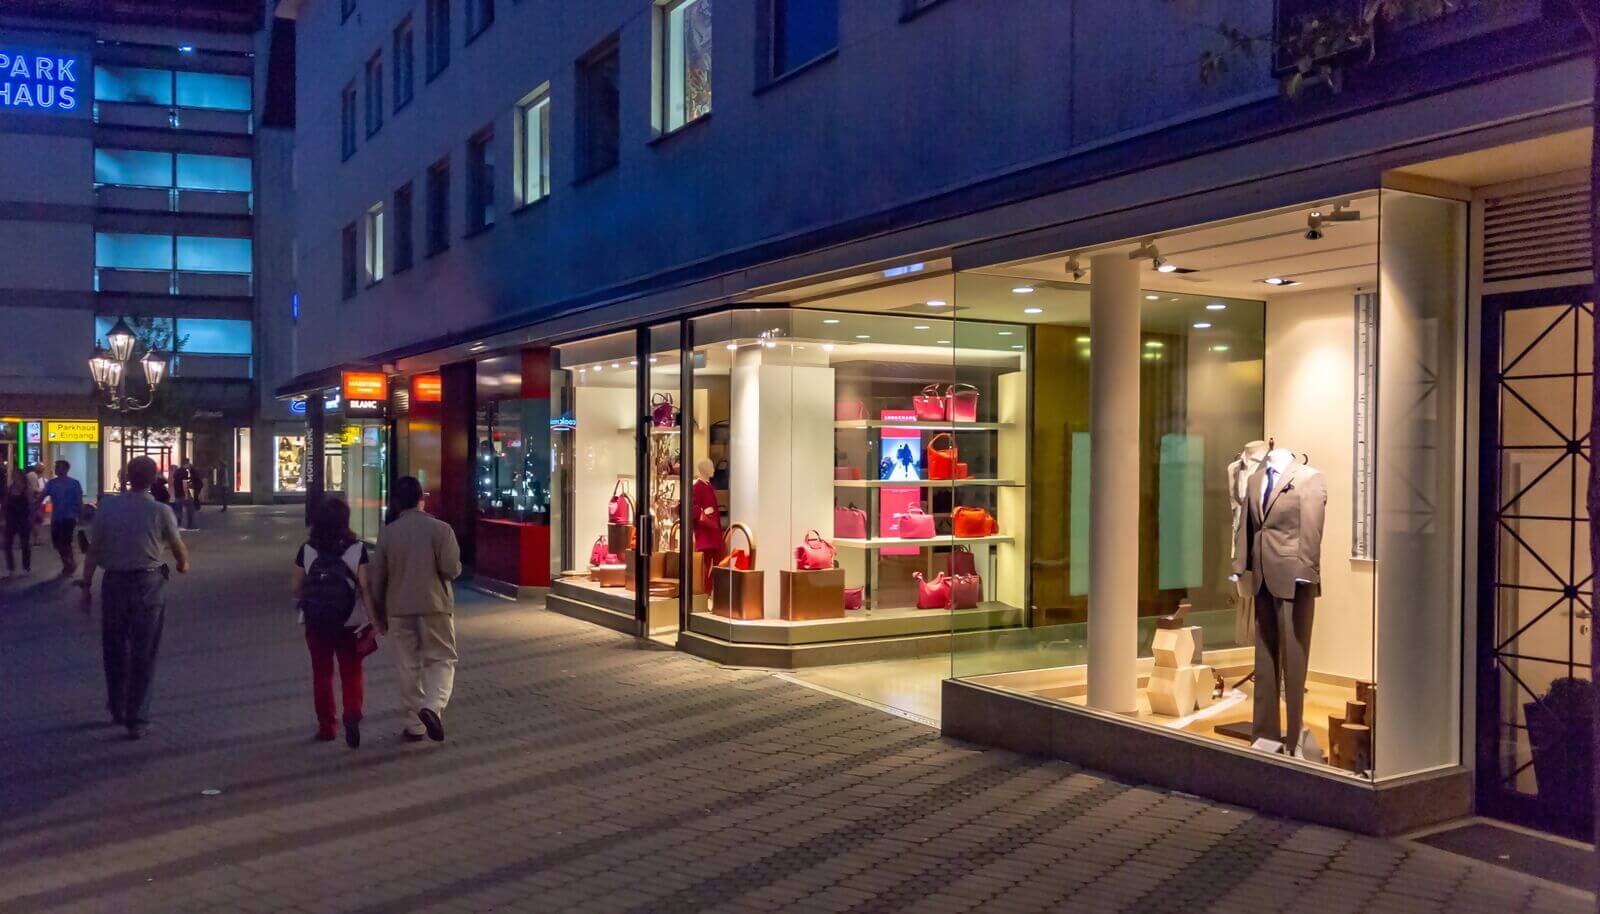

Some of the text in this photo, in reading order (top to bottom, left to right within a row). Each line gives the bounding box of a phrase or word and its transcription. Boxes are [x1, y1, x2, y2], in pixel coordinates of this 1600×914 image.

[0, 54, 75, 81] PARK
[0, 82, 76, 109] HAUS
[350, 400, 377, 409] BLANC
[305, 428, 314, 482] MONTBLANC
